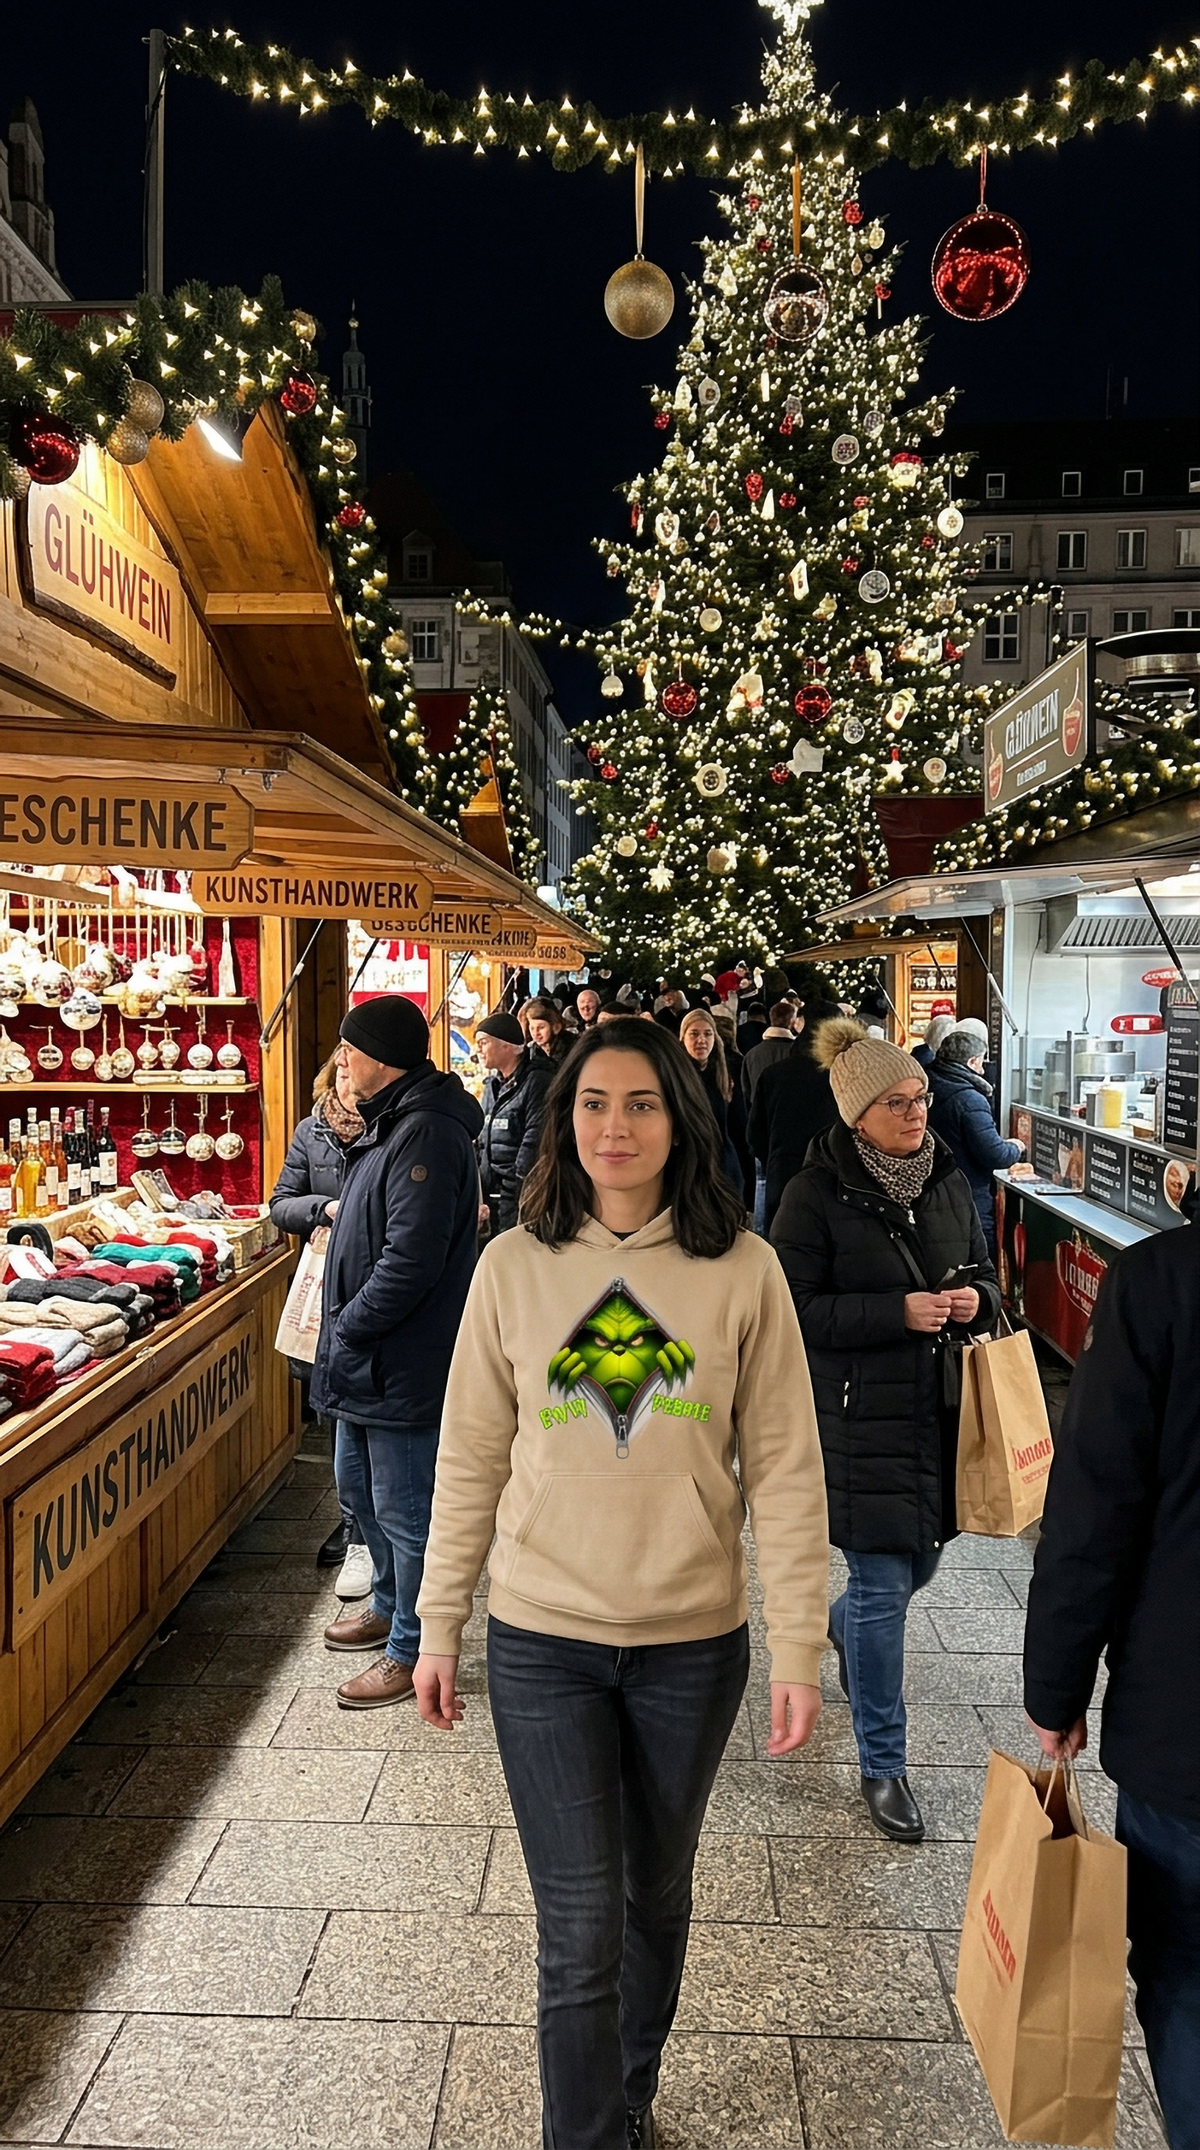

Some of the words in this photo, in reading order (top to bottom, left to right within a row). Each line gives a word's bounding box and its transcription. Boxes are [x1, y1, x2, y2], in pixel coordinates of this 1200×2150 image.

[44, 503, 171, 645] GLÜHWEIN
[206, 876, 419, 909] KUNSTHANDWERK
[33, 1333, 251, 1600] KUNSTHANDWERK
